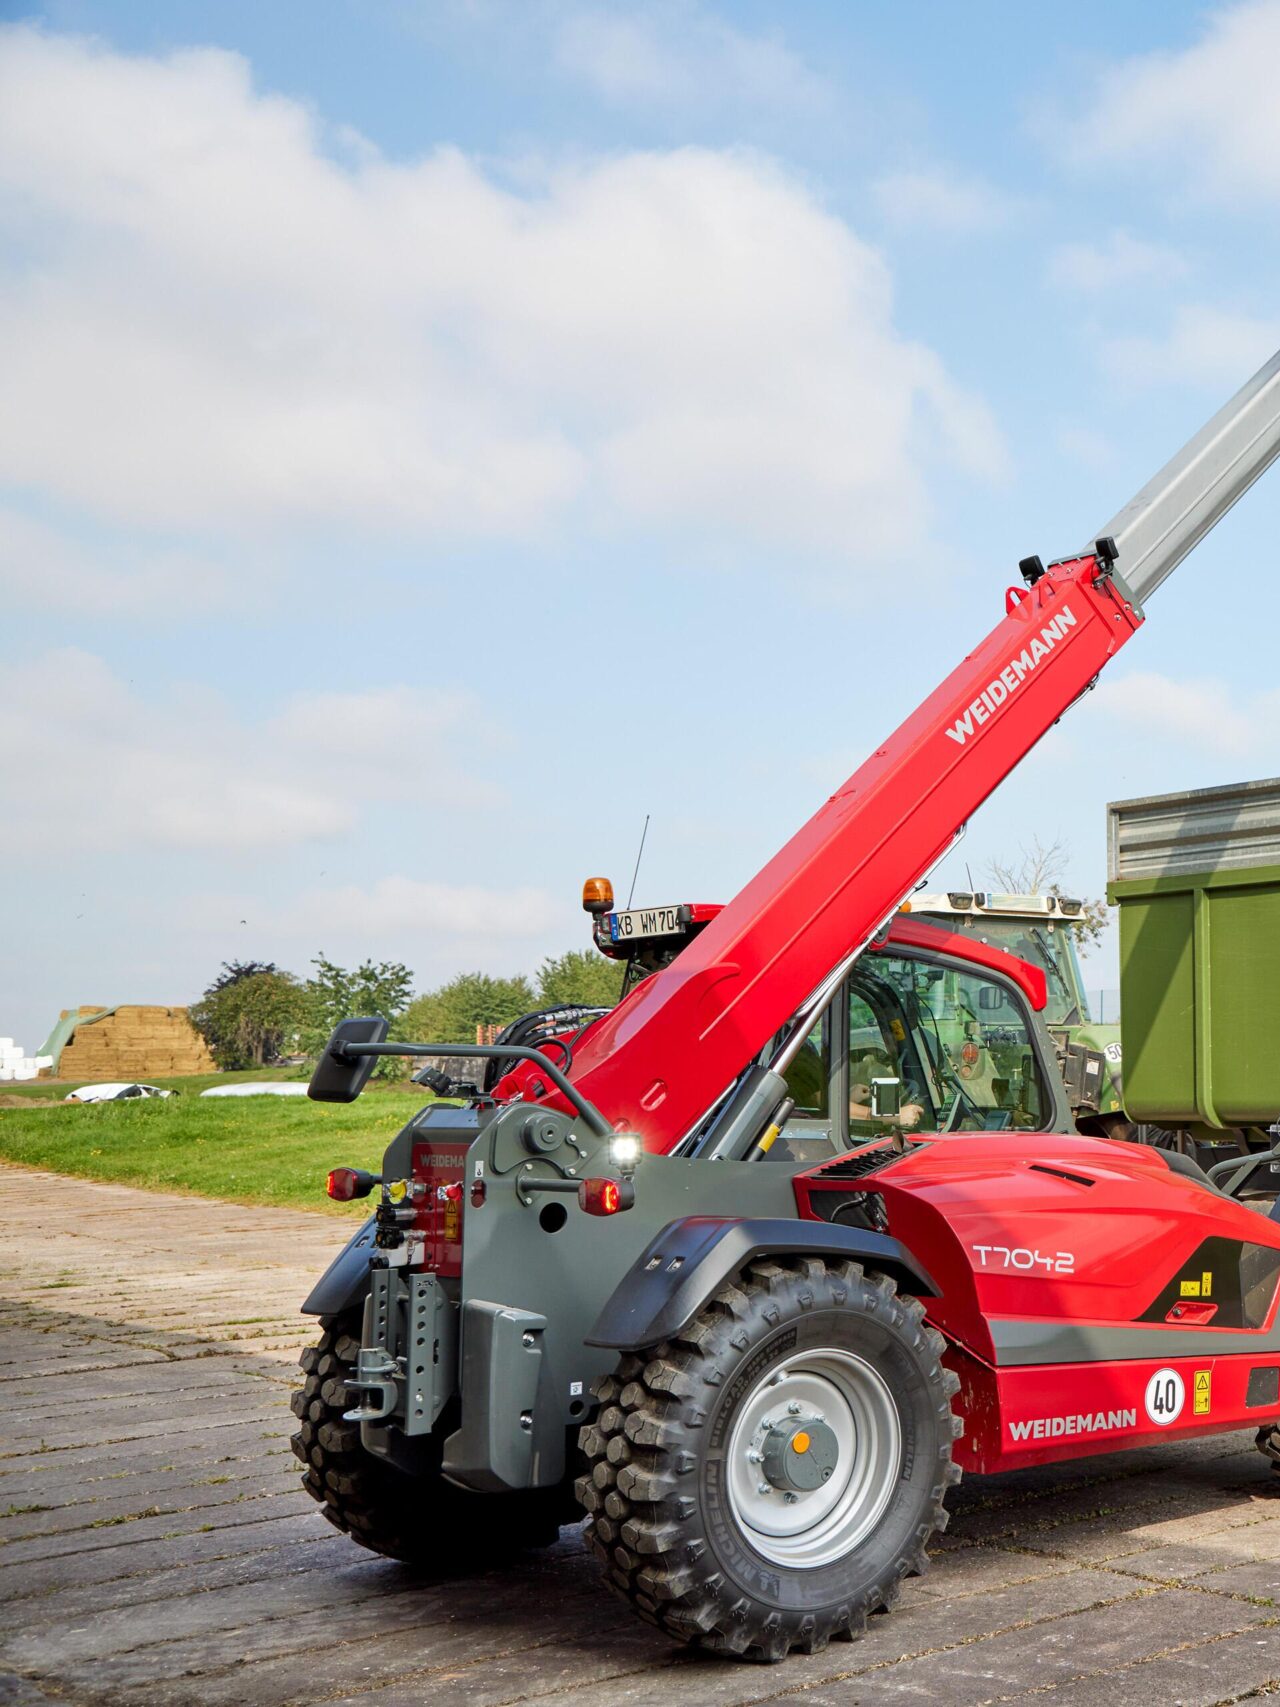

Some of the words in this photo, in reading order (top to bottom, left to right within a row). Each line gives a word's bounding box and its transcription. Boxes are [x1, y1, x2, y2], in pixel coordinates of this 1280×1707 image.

[945, 605, 1077, 745] WEIDEMANN
[617, 915, 633, 936] KB
[972, 1245, 1075, 1273] T7042
[1154, 1379, 1176, 1414] 40
[1008, 1408, 1137, 1441] WEIDEMANN
